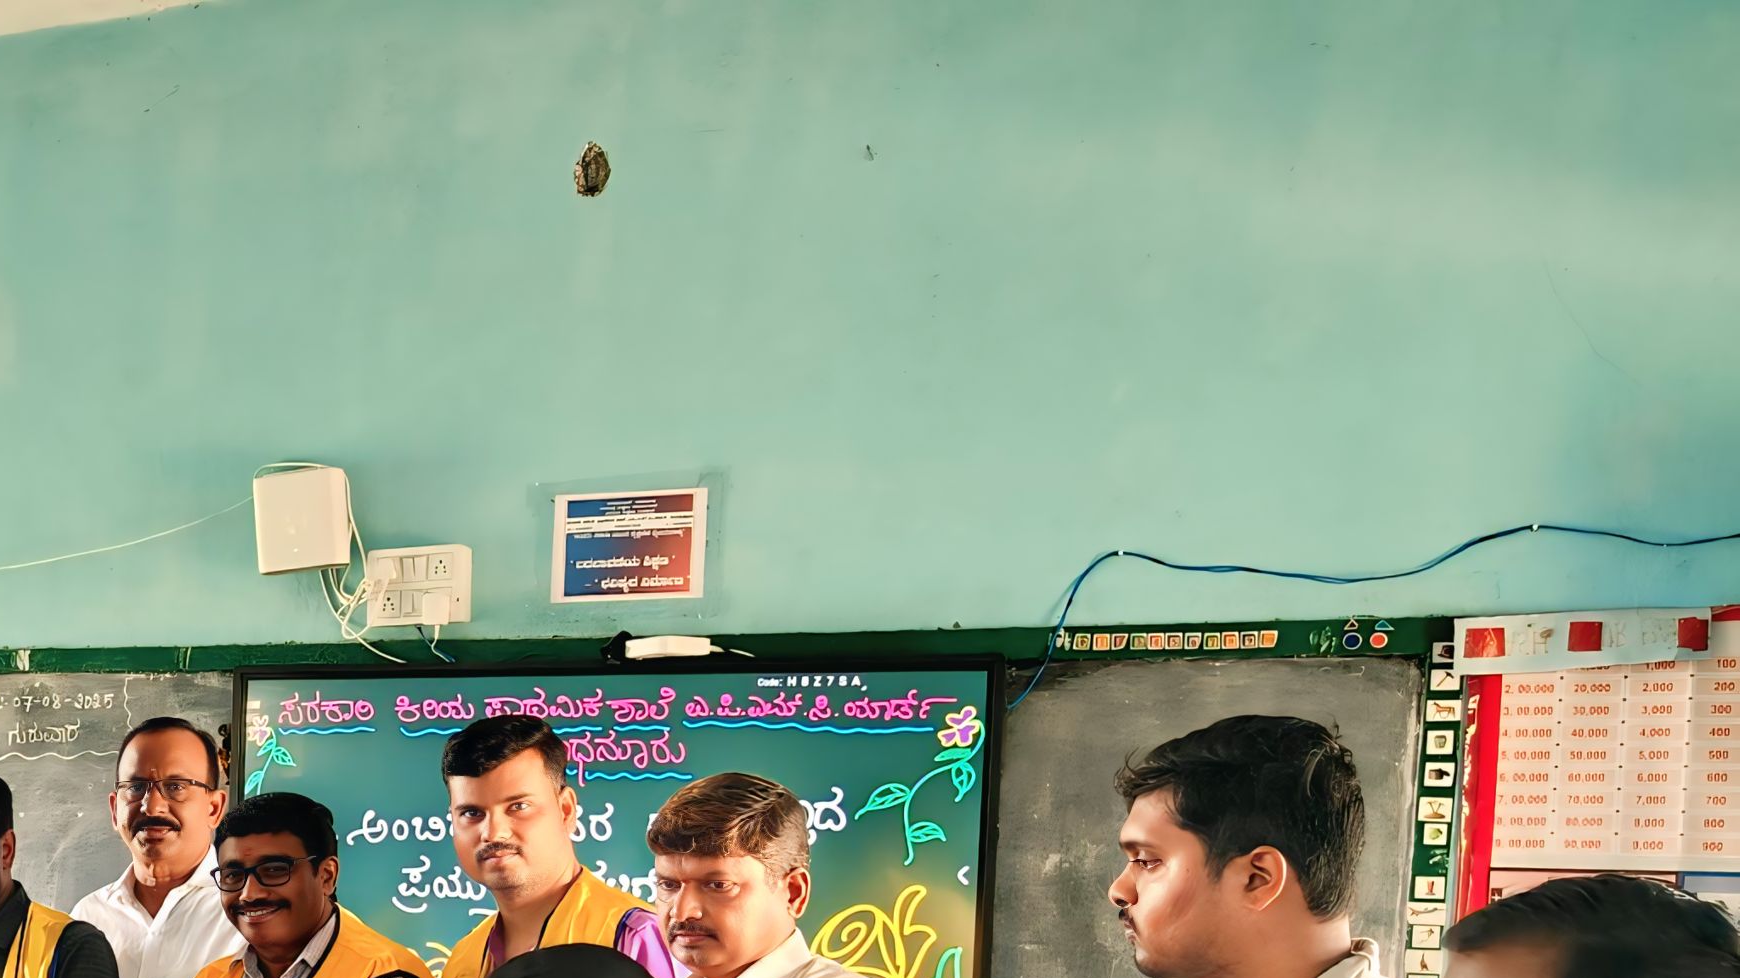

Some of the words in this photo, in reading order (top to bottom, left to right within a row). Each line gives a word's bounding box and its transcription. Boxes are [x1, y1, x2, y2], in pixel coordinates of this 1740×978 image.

[278, 690, 376, 725] ಸರಕಾರಿ
[605, 687, 676, 722] ಶಾಲೆ
[8, 719, 80, 746] ಗುರುವಾರ
